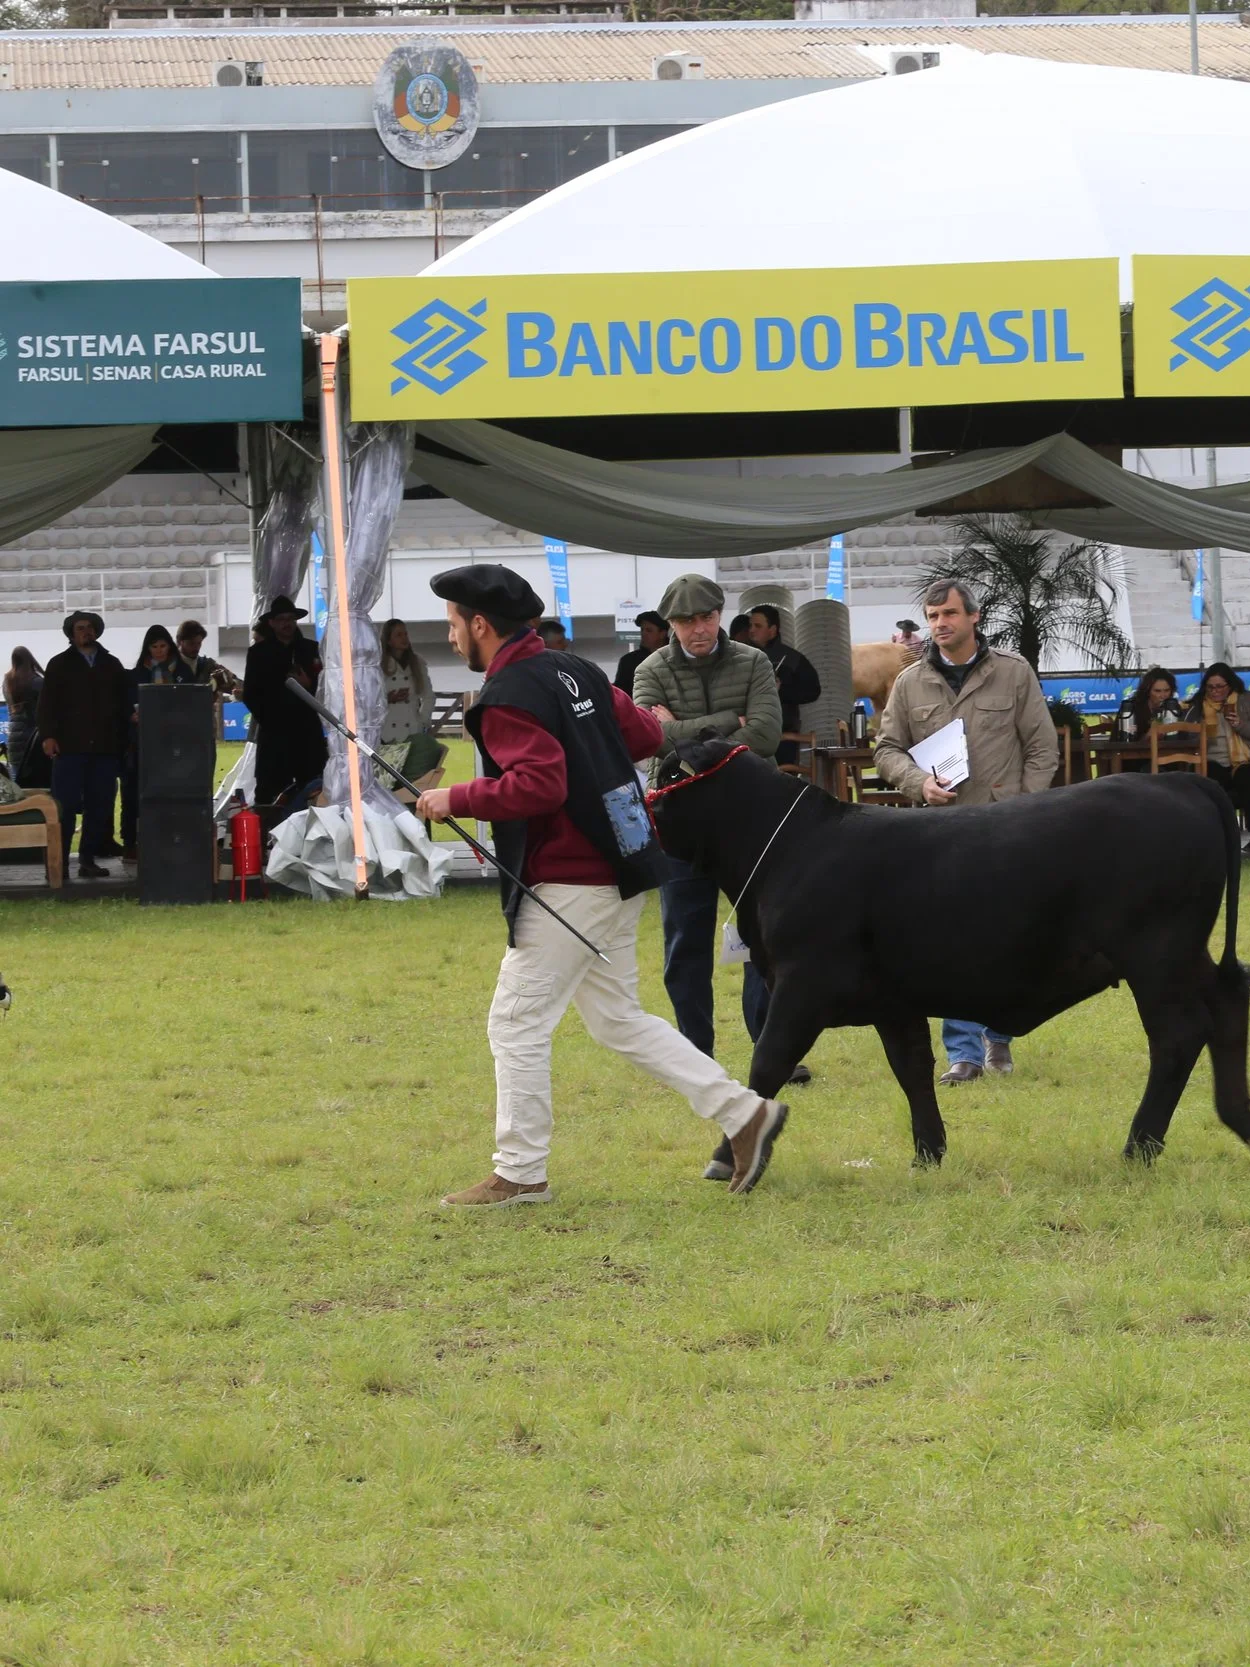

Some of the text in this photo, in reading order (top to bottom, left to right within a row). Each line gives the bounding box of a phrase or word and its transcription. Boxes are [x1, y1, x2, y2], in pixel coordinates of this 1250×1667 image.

[17, 331, 266, 359] SISTEMA FARSUL
[506, 302, 1085, 378] BANCO DO BRASIL
[18, 362, 267, 383] FARSUL SENAR CASA RURAL
[1089, 693, 1117, 701] CAIXA
